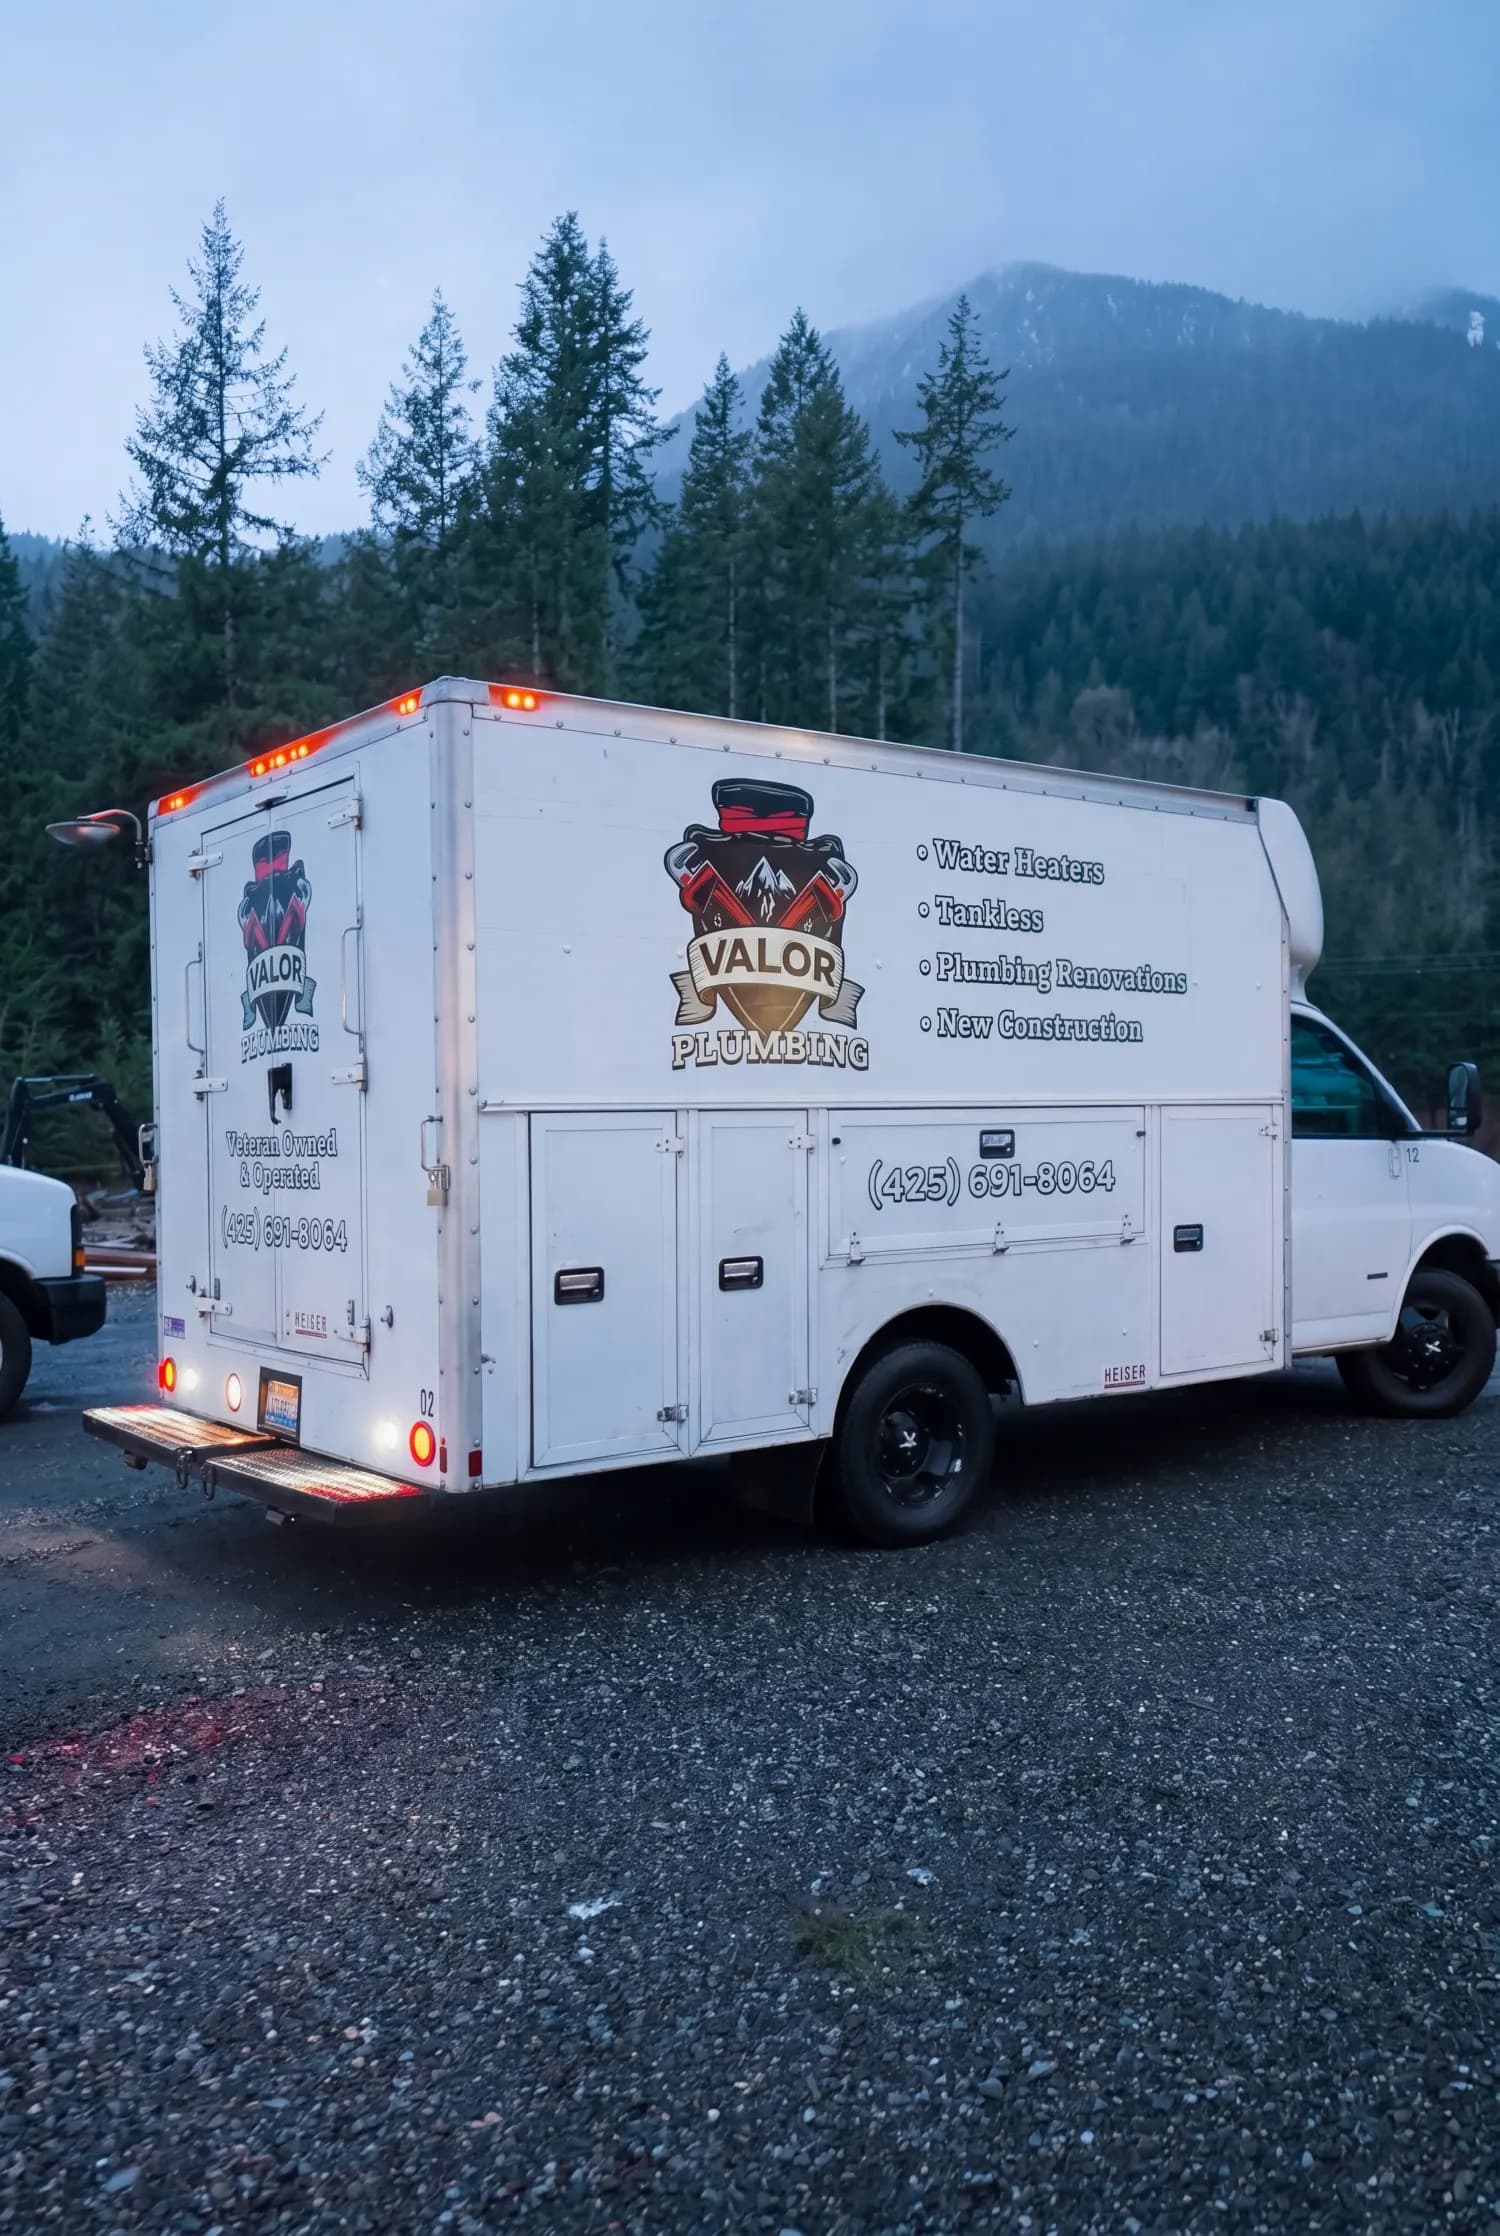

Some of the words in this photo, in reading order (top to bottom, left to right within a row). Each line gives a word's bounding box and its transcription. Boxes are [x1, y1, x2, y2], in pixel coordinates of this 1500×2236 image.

[933, 838, 1009, 874] Water
[1014, 848, 1105, 884] Heaters
[935, 895, 1044, 933] Tankless
[249, 953, 303, 991] VALOR
[699, 937, 836, 988] VALOR
[936, 952, 1052, 994] Plumbing
[1055, 959, 1188, 994] Renovations
[240, 1023, 320, 1064] PLUMBING
[937, 1007, 994, 1039] New
[997, 1009, 1144, 1043] Construction
[671, 1029, 870, 1071] PLUMBING
[226, 1131, 281, 1158] Veteran
[282, 1128, 338, 1158] Owned
[1406, 1147, 1421, 1163] 12
[239, 1161, 250, 1188] &
[252, 1161, 320, 1195] Operated
[868, 1156, 961, 1211] (425)
[967, 1160, 1116, 1199] 691-8064
[221, 1205, 261, 1251] (425)
[263, 1215, 348, 1252] 691-8064
[1104, 1364, 1147, 1383] HEISER
[420, 1388, 434, 1418] 02
